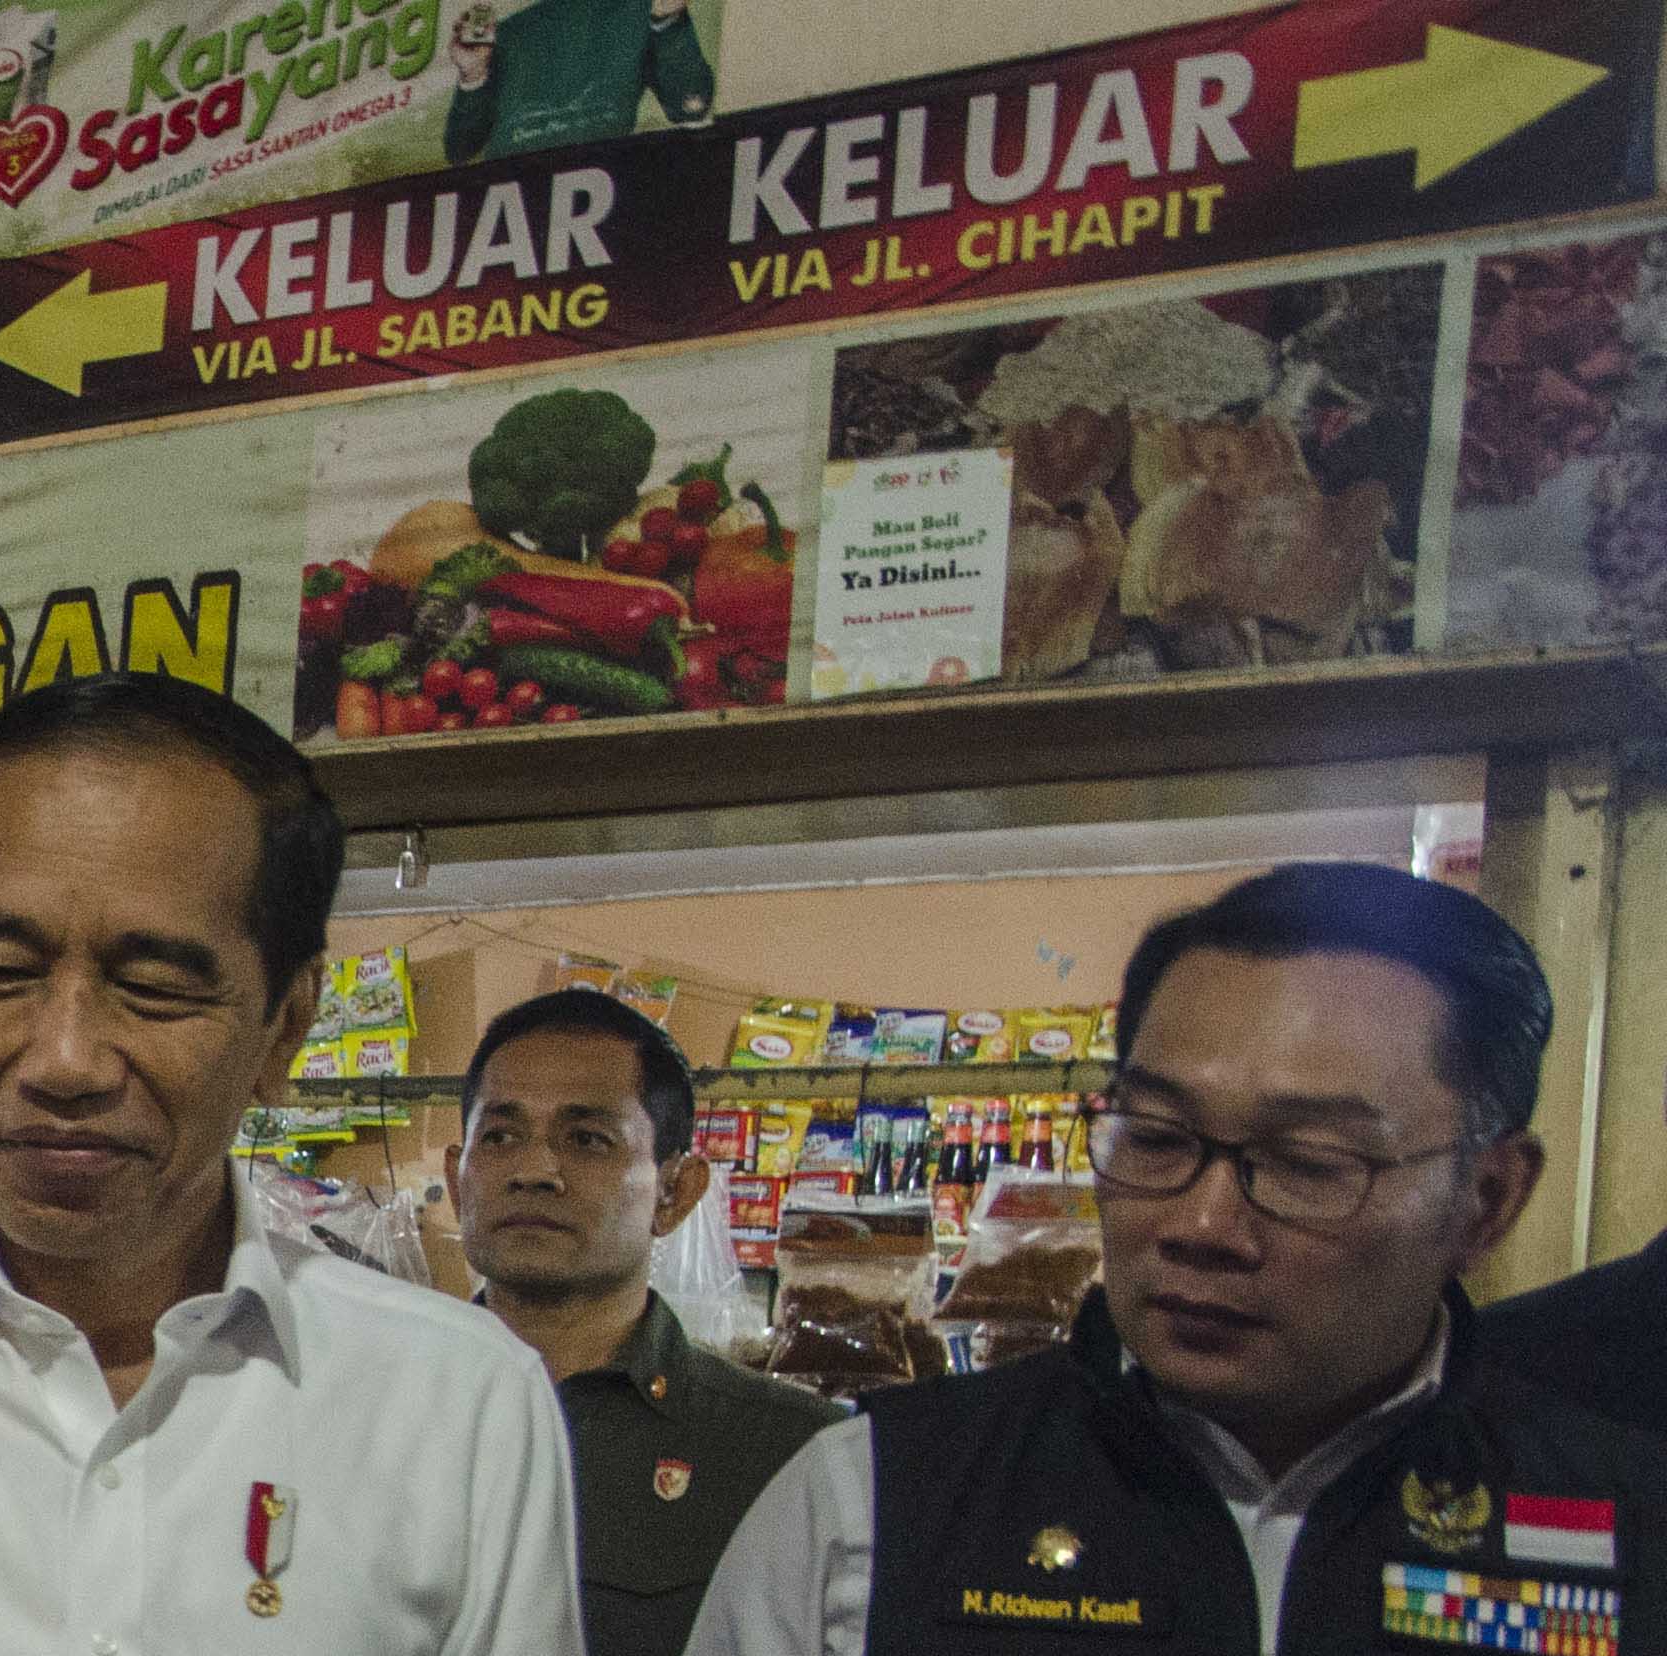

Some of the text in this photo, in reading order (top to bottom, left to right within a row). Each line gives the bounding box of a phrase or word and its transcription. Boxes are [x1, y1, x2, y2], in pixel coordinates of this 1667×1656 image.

[208, 148, 254, 181] SASA
[256, 118, 331, 161] SANTAN
[331, 93, 397, 133] OMEGA
[727, 50, 1256, 245] KELUAR
[190, 166, 616, 333] KELUAR
[729, 184, 1226, 304] VIA JL. CIHAPIT
[192, 282, 611, 385] VIA JL. SABANG
[840, 570, 873, 590] Ya
